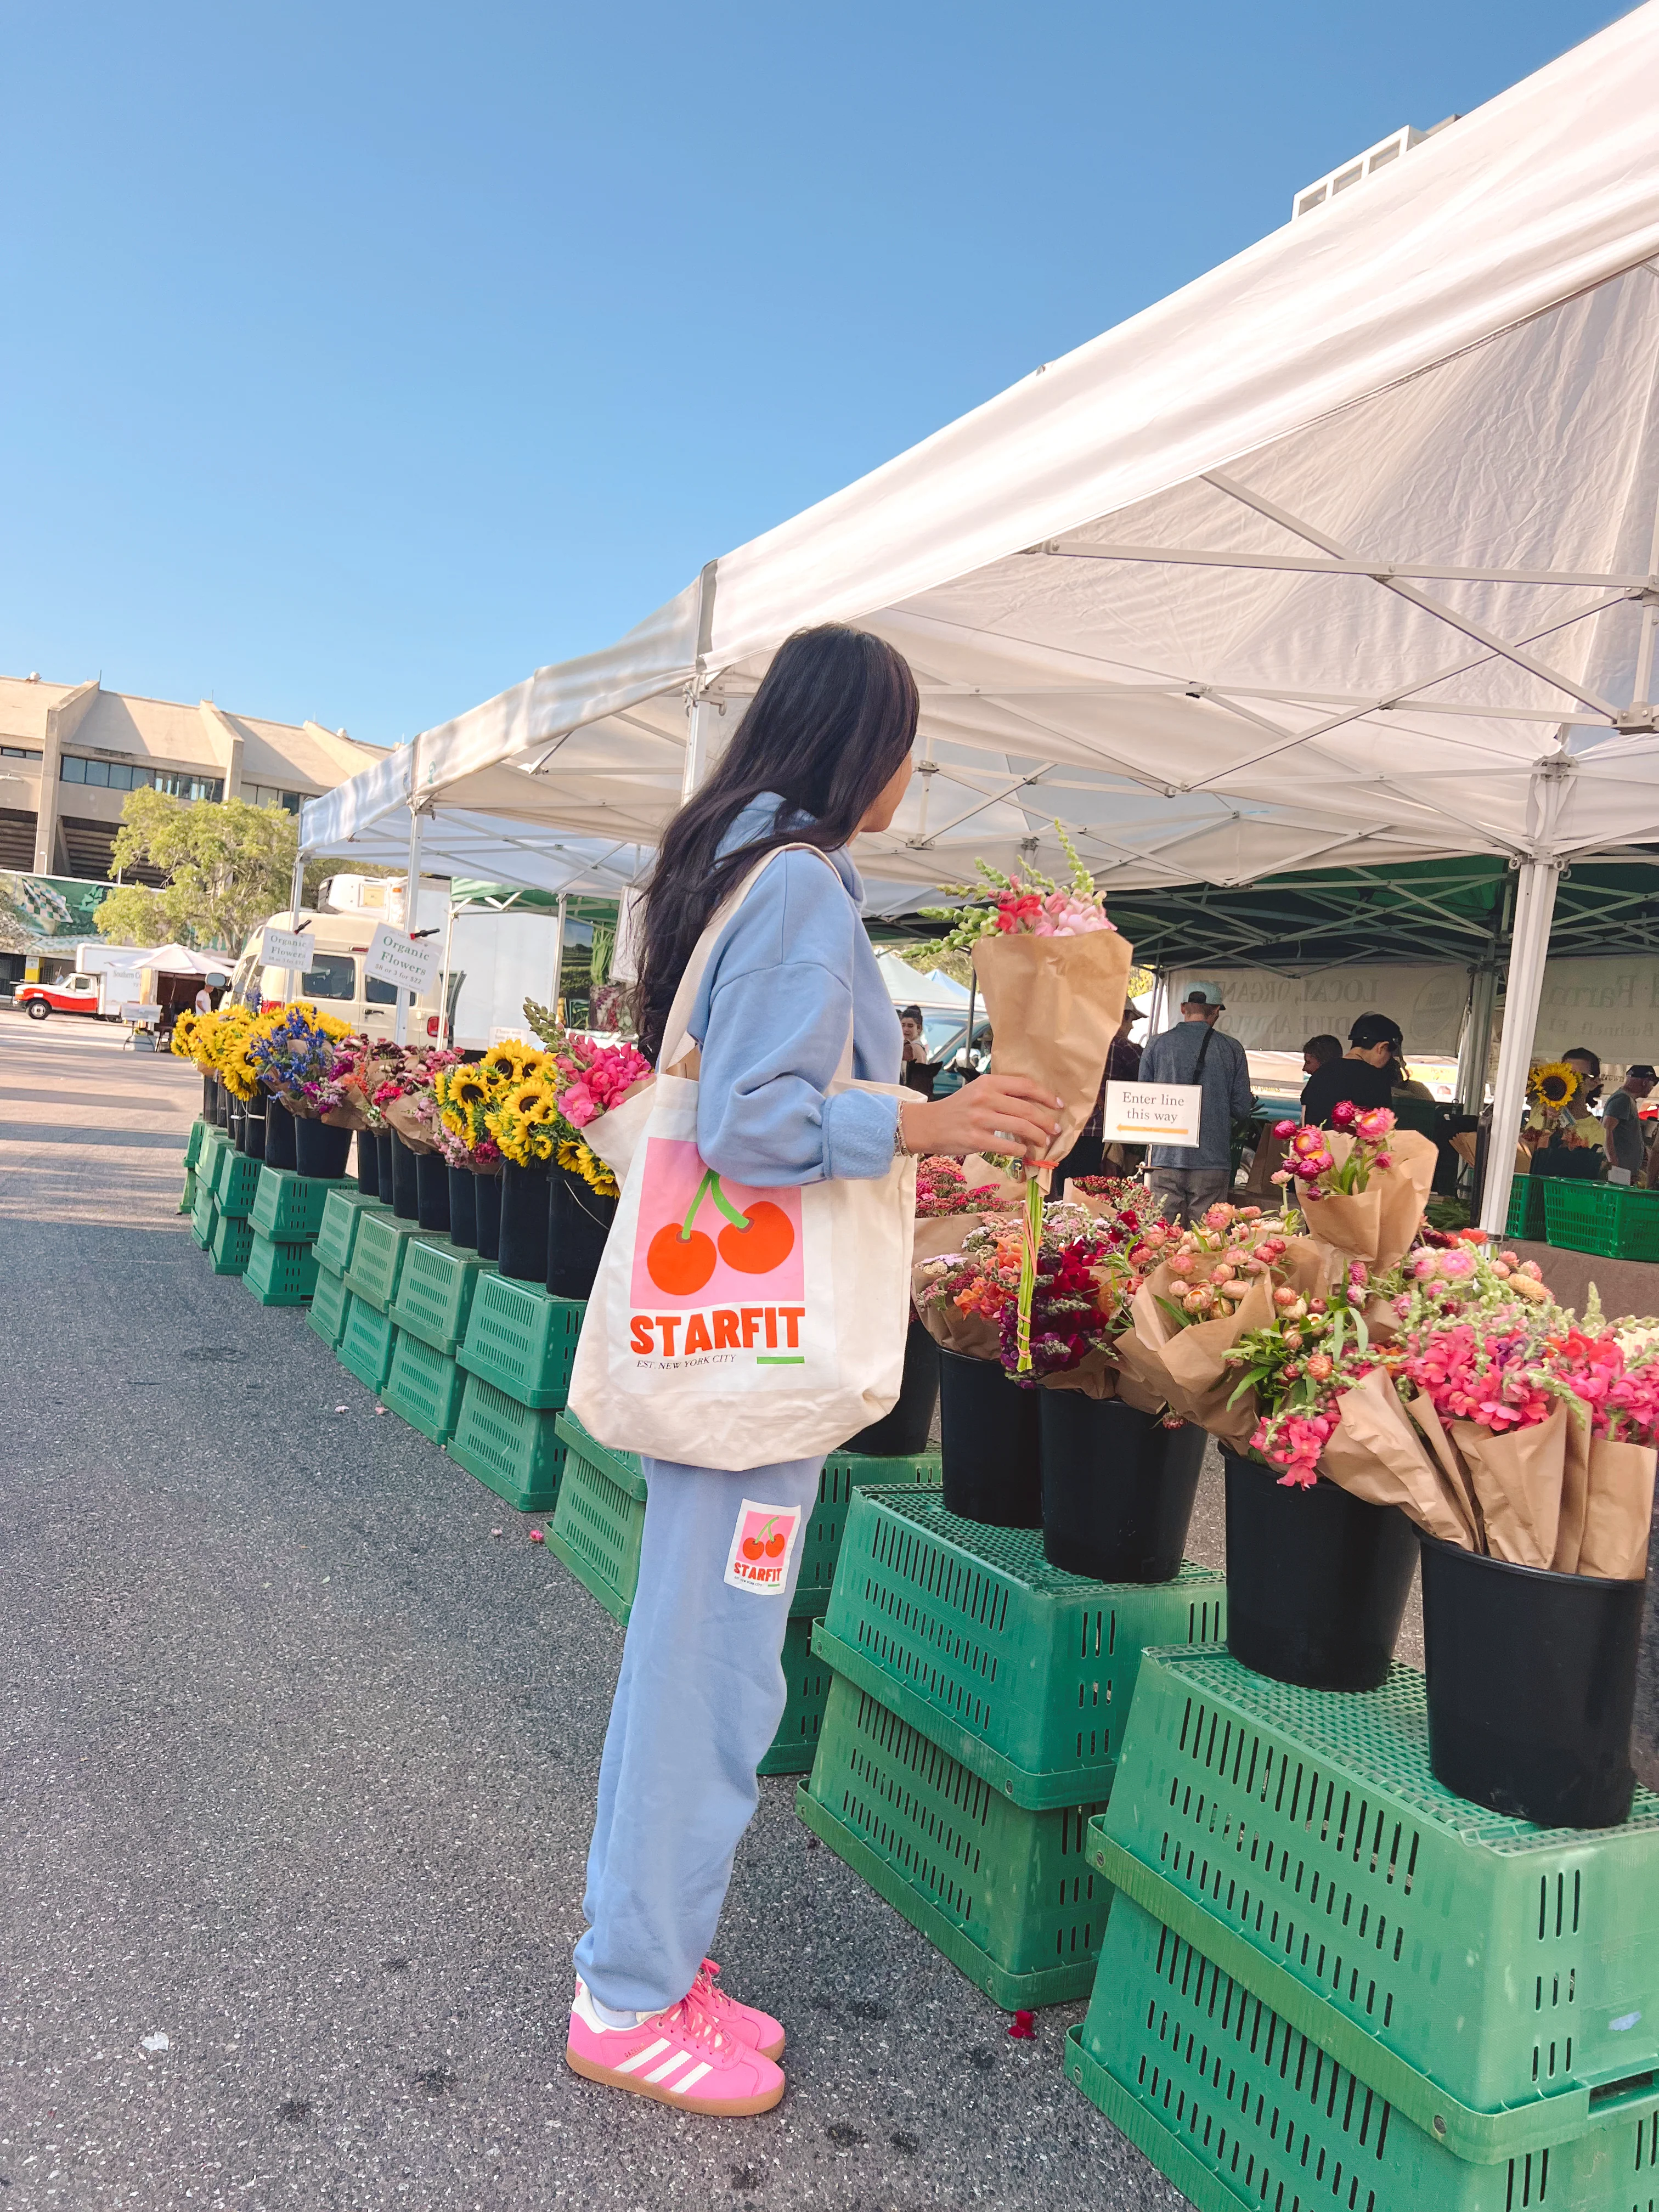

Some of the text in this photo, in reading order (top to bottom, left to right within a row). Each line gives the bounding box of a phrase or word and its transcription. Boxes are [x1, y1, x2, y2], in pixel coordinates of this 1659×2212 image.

[270, 935, 307, 947] Organic
[383, 935, 430, 961] Organic
[271, 946, 306, 958] Flowers
[380, 951, 426, 976] Flowers
[410, 977, 422, 985] $22
[1122, 1092, 1184, 1106] Enter line
[1127, 1108, 1178, 1124] this way
[630, 1307, 805, 1356] STARFIT
[636, 1354, 737, 1370] EST. NEW YORK CITY
[733, 1562, 782, 1582] STARFIT
